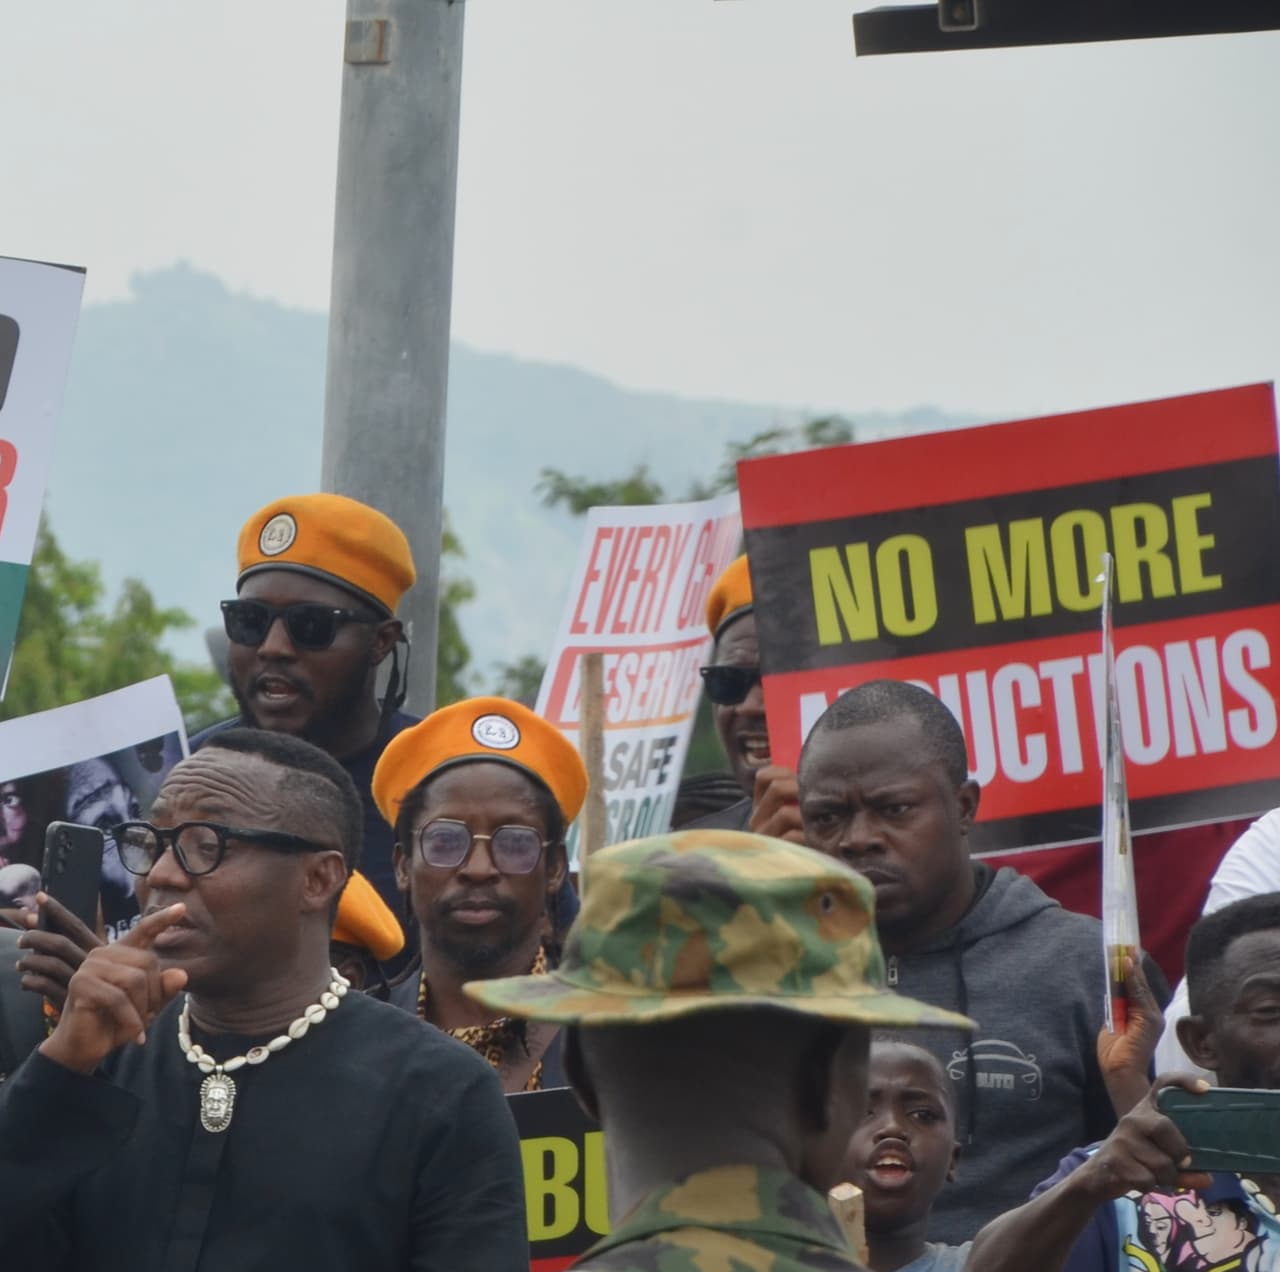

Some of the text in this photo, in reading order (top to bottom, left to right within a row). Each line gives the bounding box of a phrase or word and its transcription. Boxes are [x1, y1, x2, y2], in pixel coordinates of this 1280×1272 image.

[569, 524, 693, 635] EVERY
[809, 533, 939, 647] NO
[964, 492, 1223, 625] MORE
[604, 735, 678, 792] SAFE
[799, 629, 1279, 790] UCTIONS
